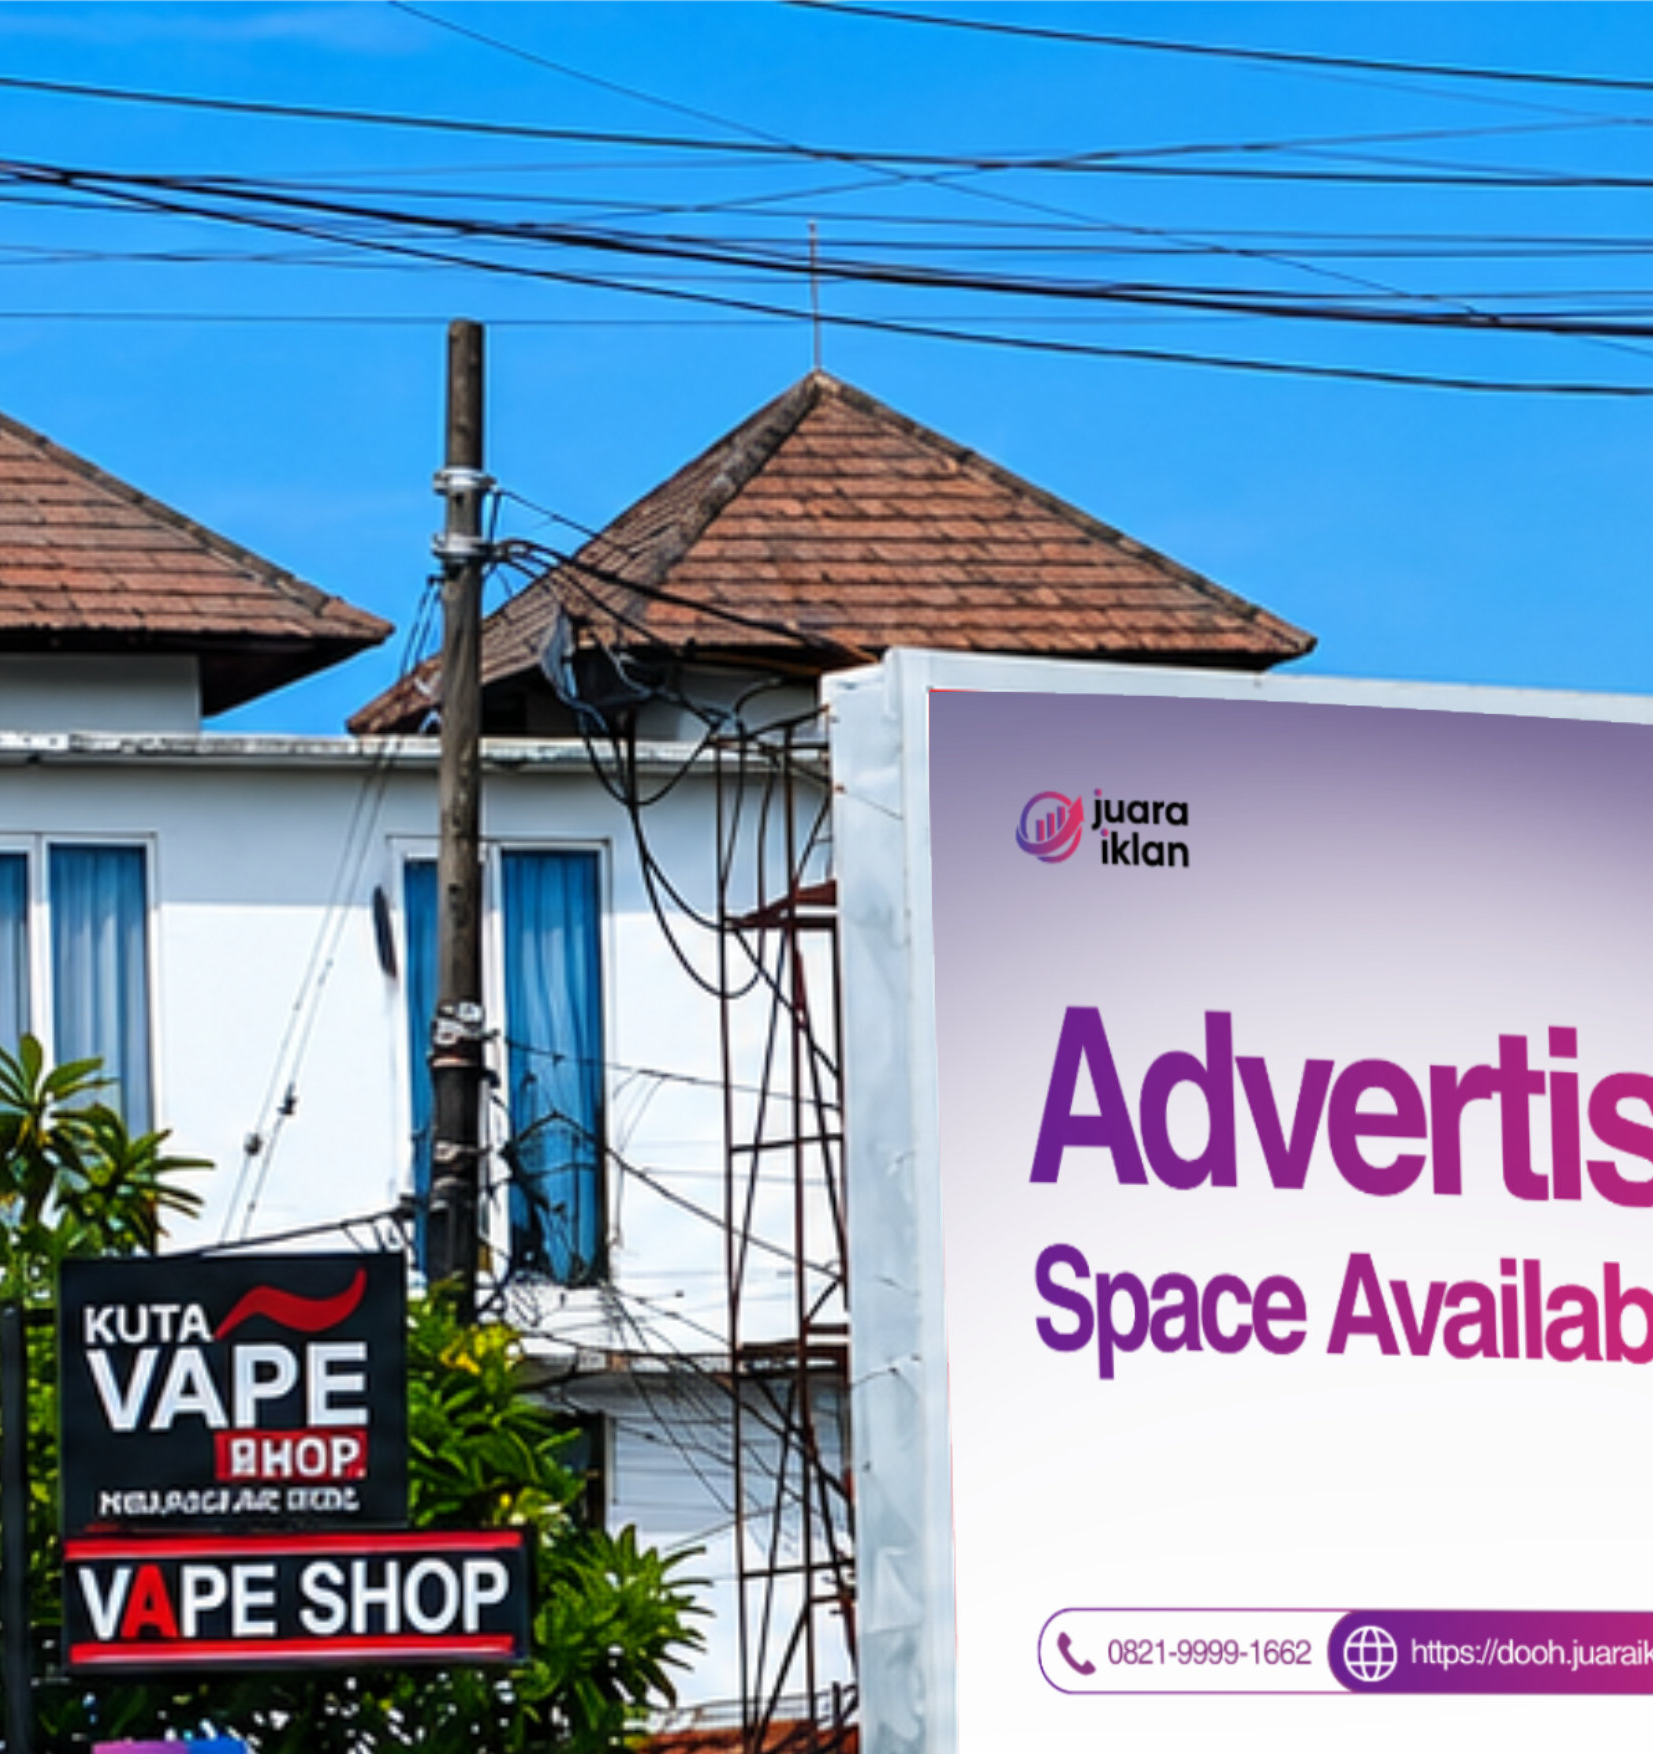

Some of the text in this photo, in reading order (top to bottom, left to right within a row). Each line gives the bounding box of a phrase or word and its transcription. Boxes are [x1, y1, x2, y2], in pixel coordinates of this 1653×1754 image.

[1092, 788, 1189, 831] juara
[1101, 828, 1189, 867] iklan
[84, 1303, 214, 1344] KUTA
[1034, 1243, 1307, 1380] Space
[86, 1341, 369, 1432] VAPE
[78, 1557, 510, 1641] VAPE SHOP
[1107, 1638, 1313, 1665] 0821-9999-1662
